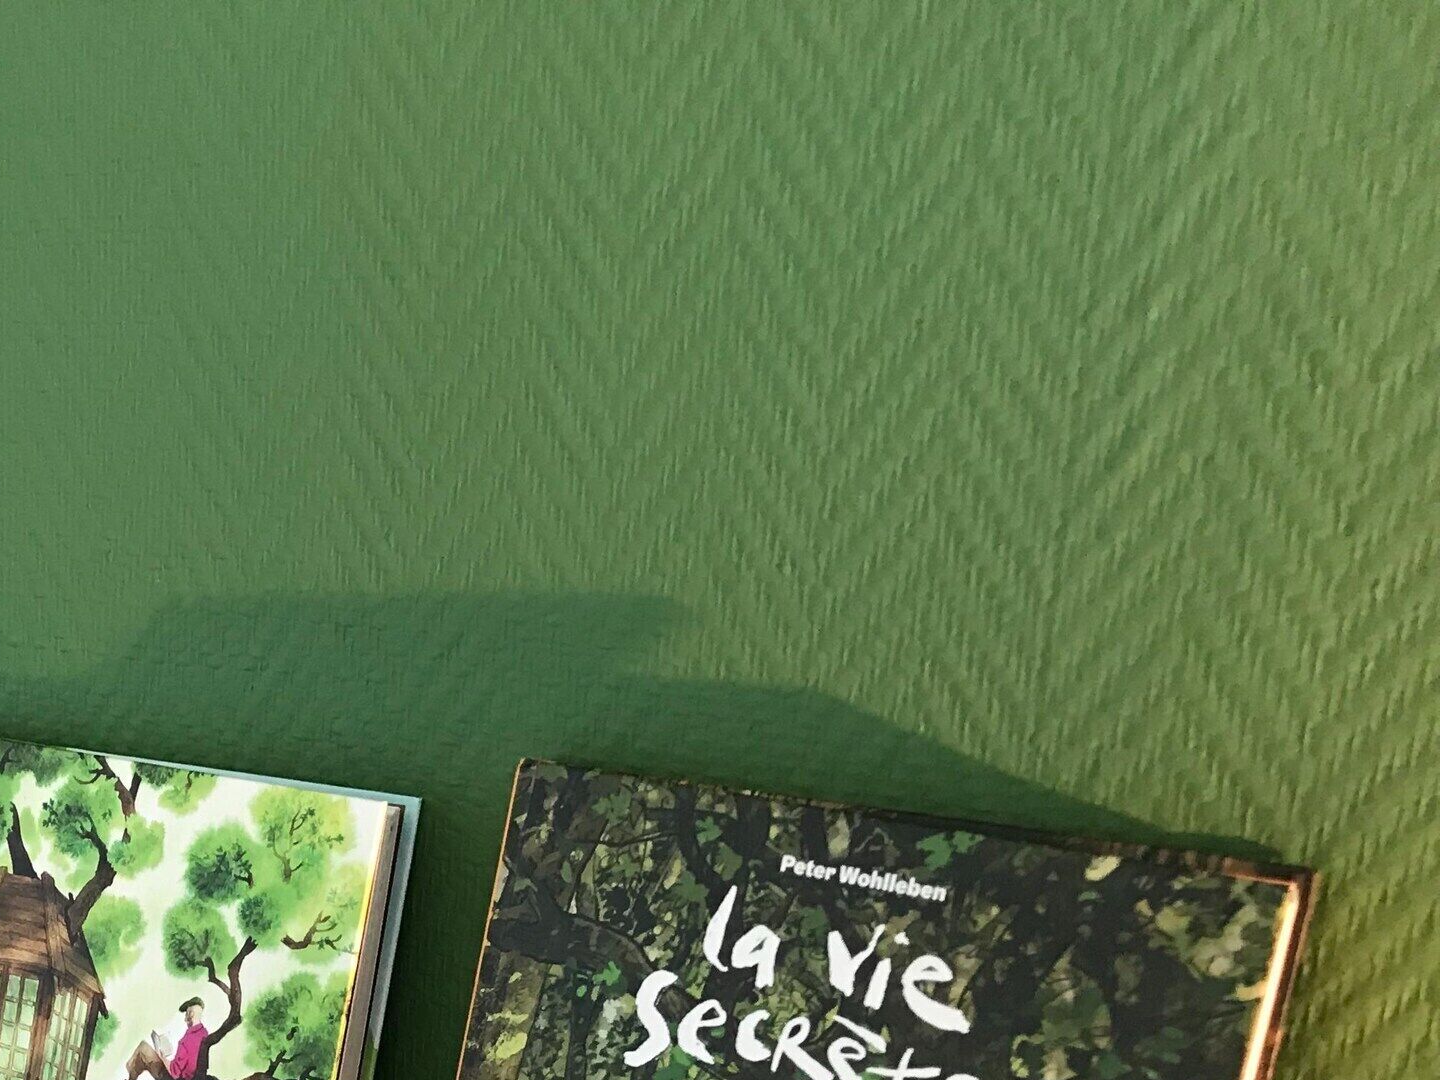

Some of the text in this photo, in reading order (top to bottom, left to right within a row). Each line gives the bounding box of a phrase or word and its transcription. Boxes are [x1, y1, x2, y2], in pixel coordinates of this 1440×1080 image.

[780, 854, 948, 902] Peter Wohlleben
[827, 922, 971, 1035] vie
